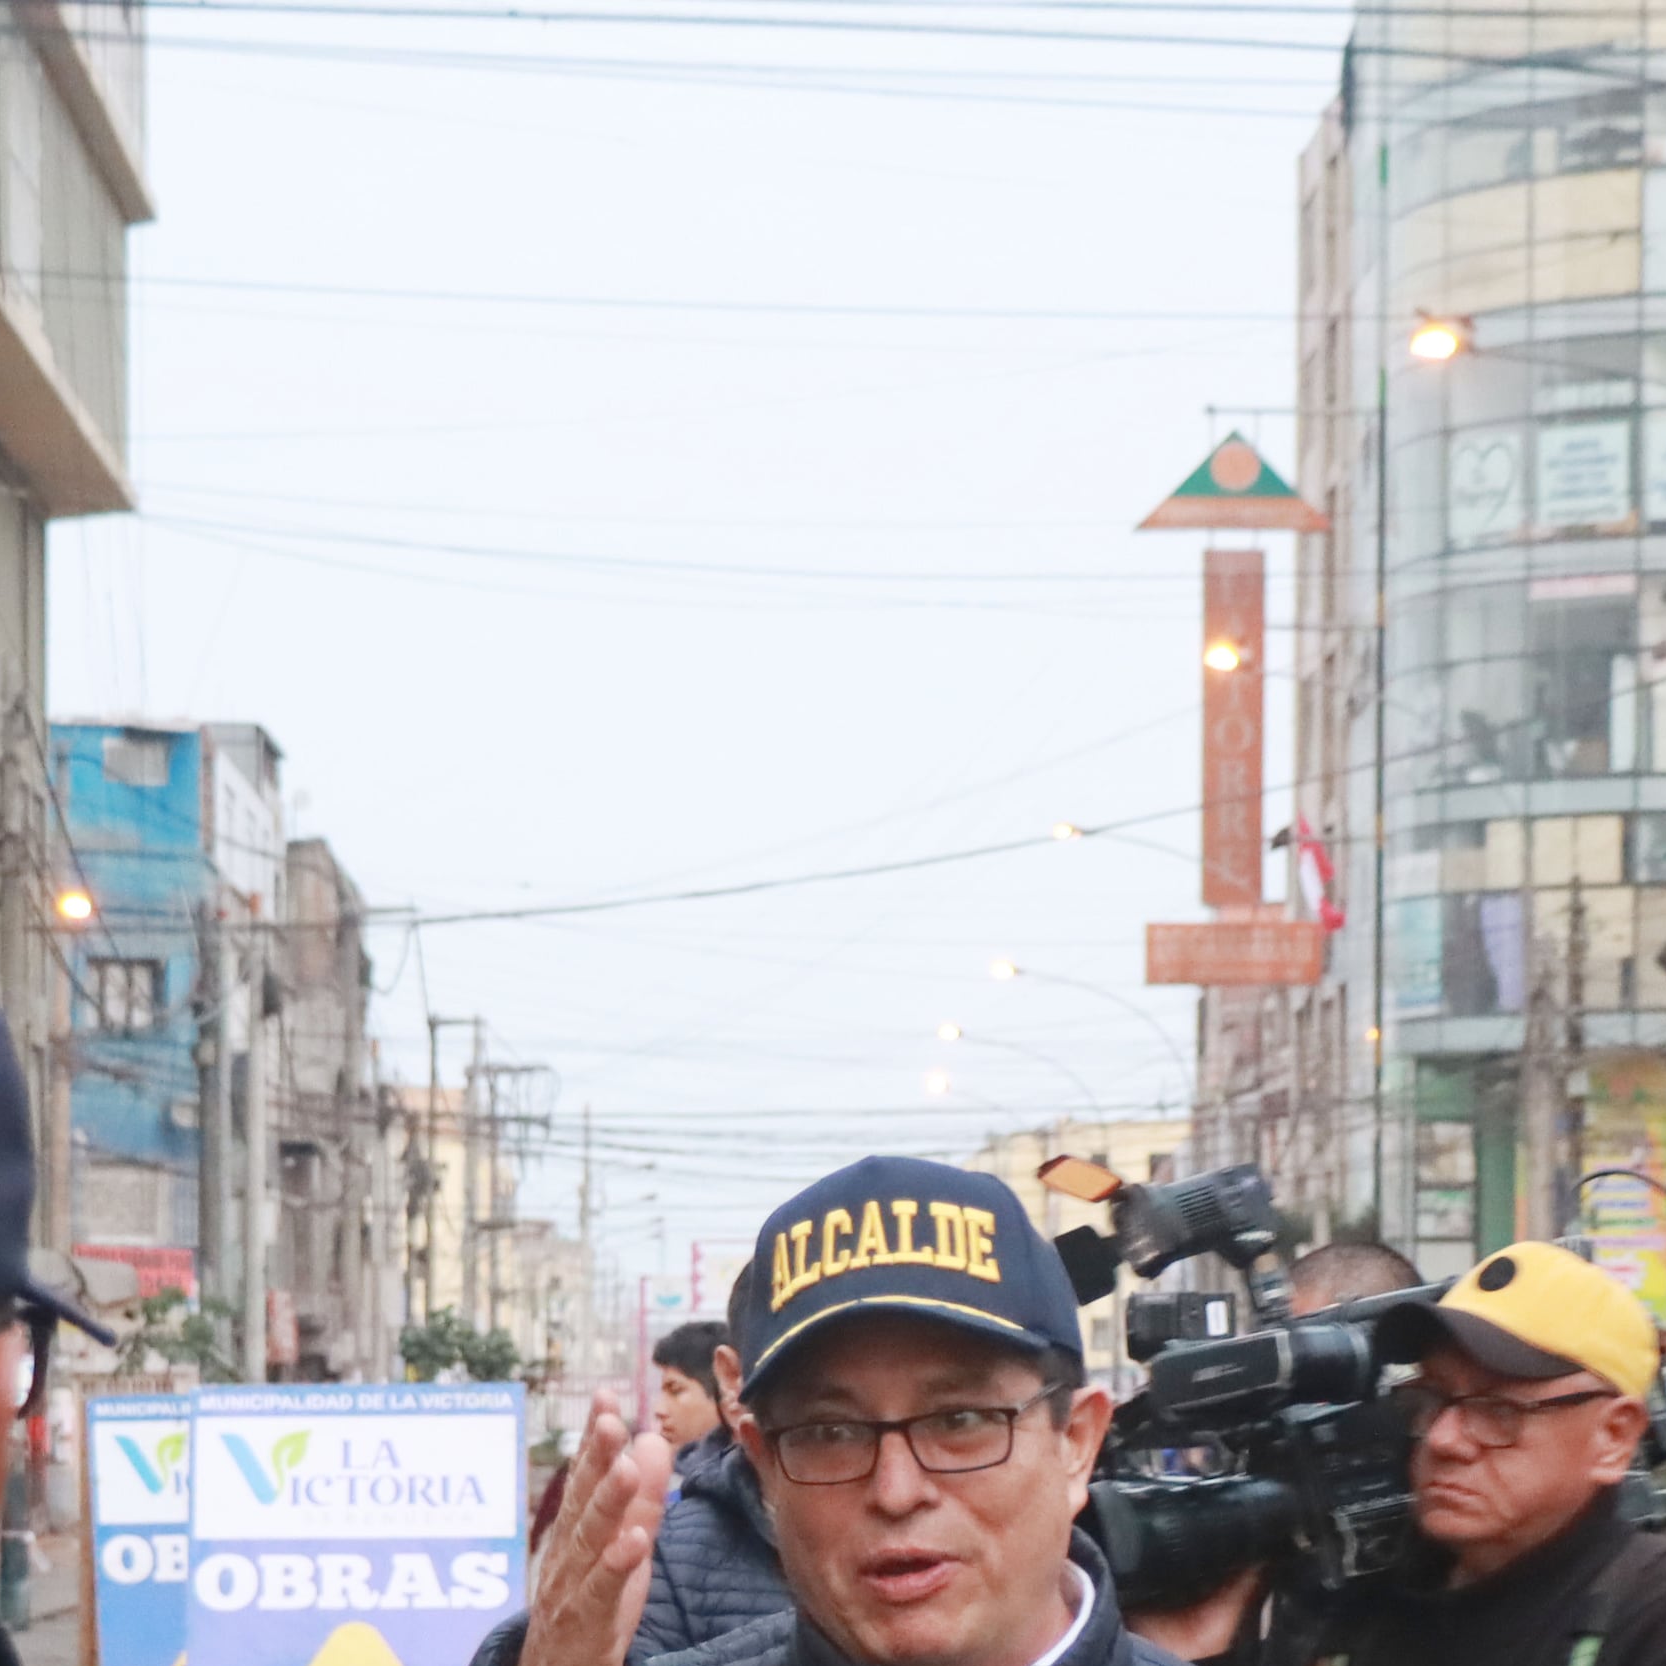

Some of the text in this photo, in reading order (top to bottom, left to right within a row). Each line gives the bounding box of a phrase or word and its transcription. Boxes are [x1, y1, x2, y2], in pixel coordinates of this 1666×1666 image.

[771, 1199, 1001, 1313] ALCALDE
[199, 1390, 515, 1411] MUNICIPALIDAD DE LA VICTORIA
[341, 1438, 402, 1470] LA
[194, 1551, 511, 1613] OBRAS
